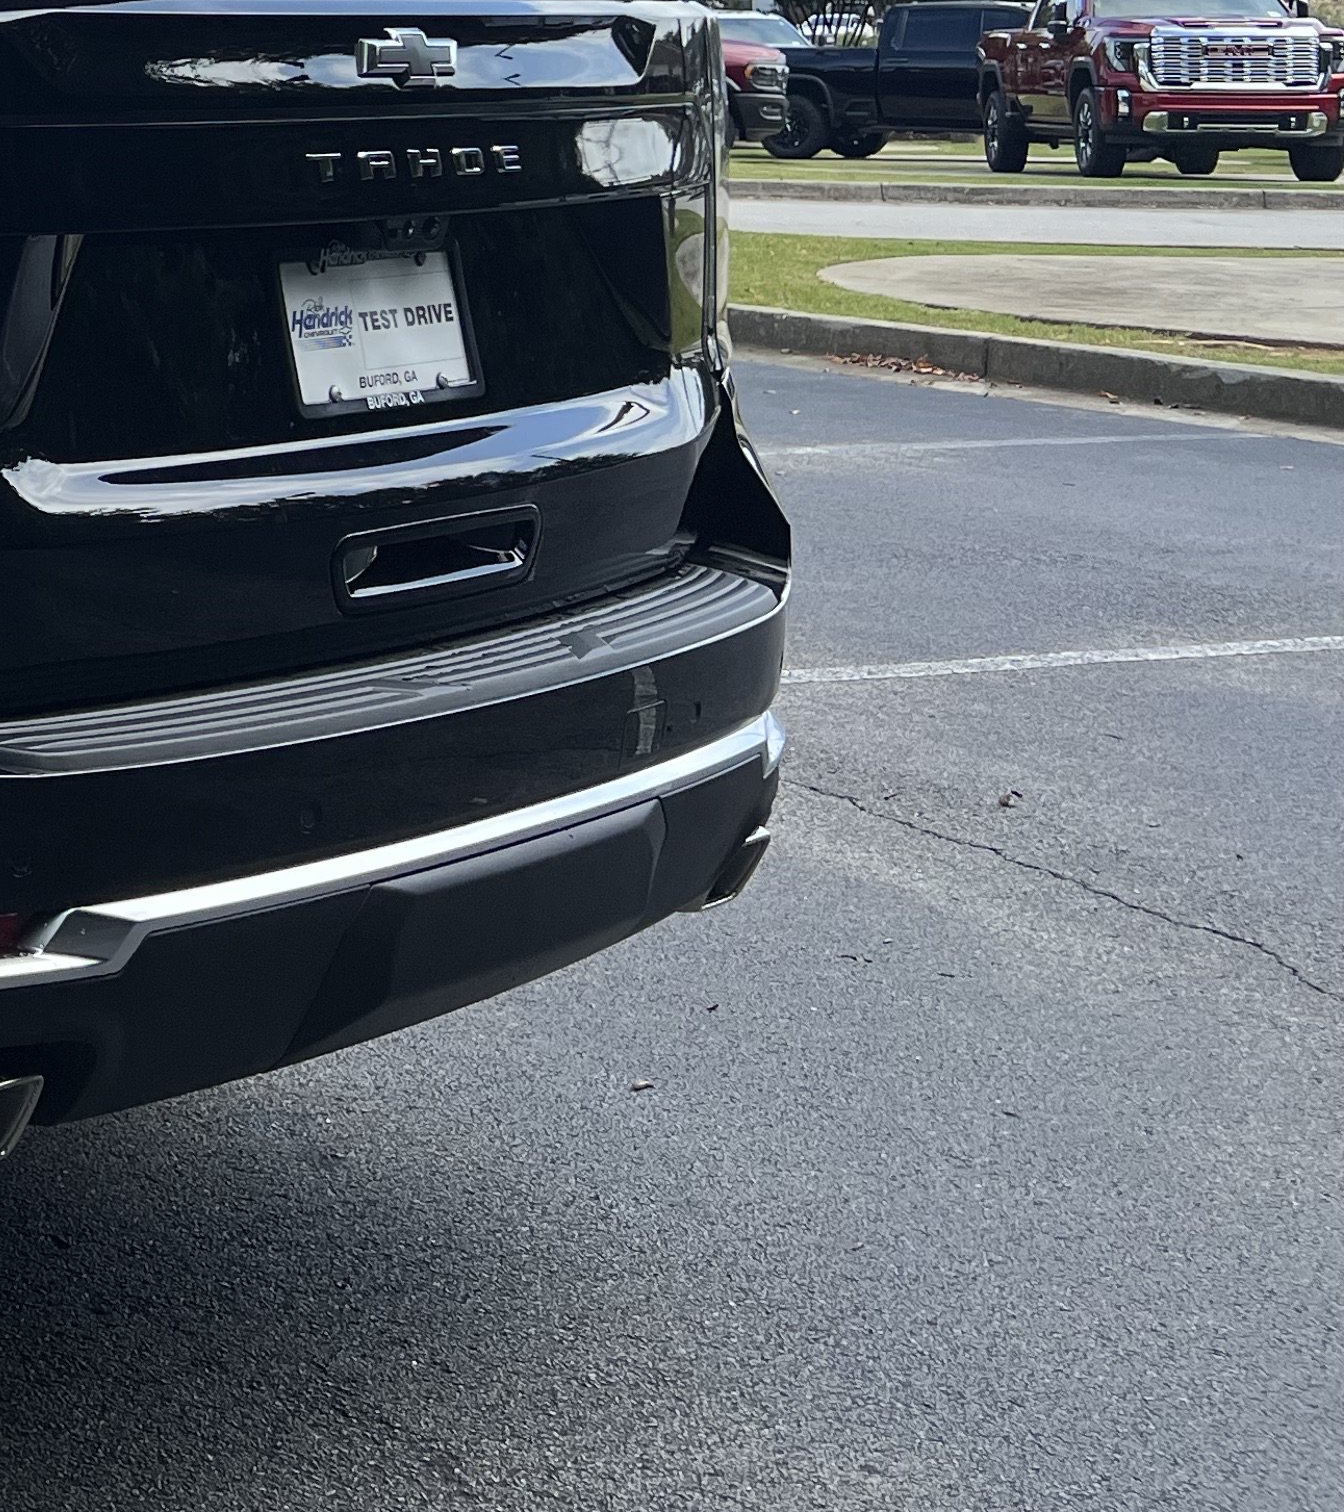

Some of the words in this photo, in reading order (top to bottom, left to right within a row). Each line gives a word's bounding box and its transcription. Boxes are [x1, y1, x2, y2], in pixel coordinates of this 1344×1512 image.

[305, 145, 522, 183] TAHOE
[292, 305, 352, 338] Hendrick
[358, 309, 399, 331] TEST
[403, 303, 454, 326] DRIVE
[359, 372, 402, 388] BUFORD,
[404, 370, 418, 382] GA
[367, 393, 410, 410] BUFORD,
[409, 391, 425, 404] GA
